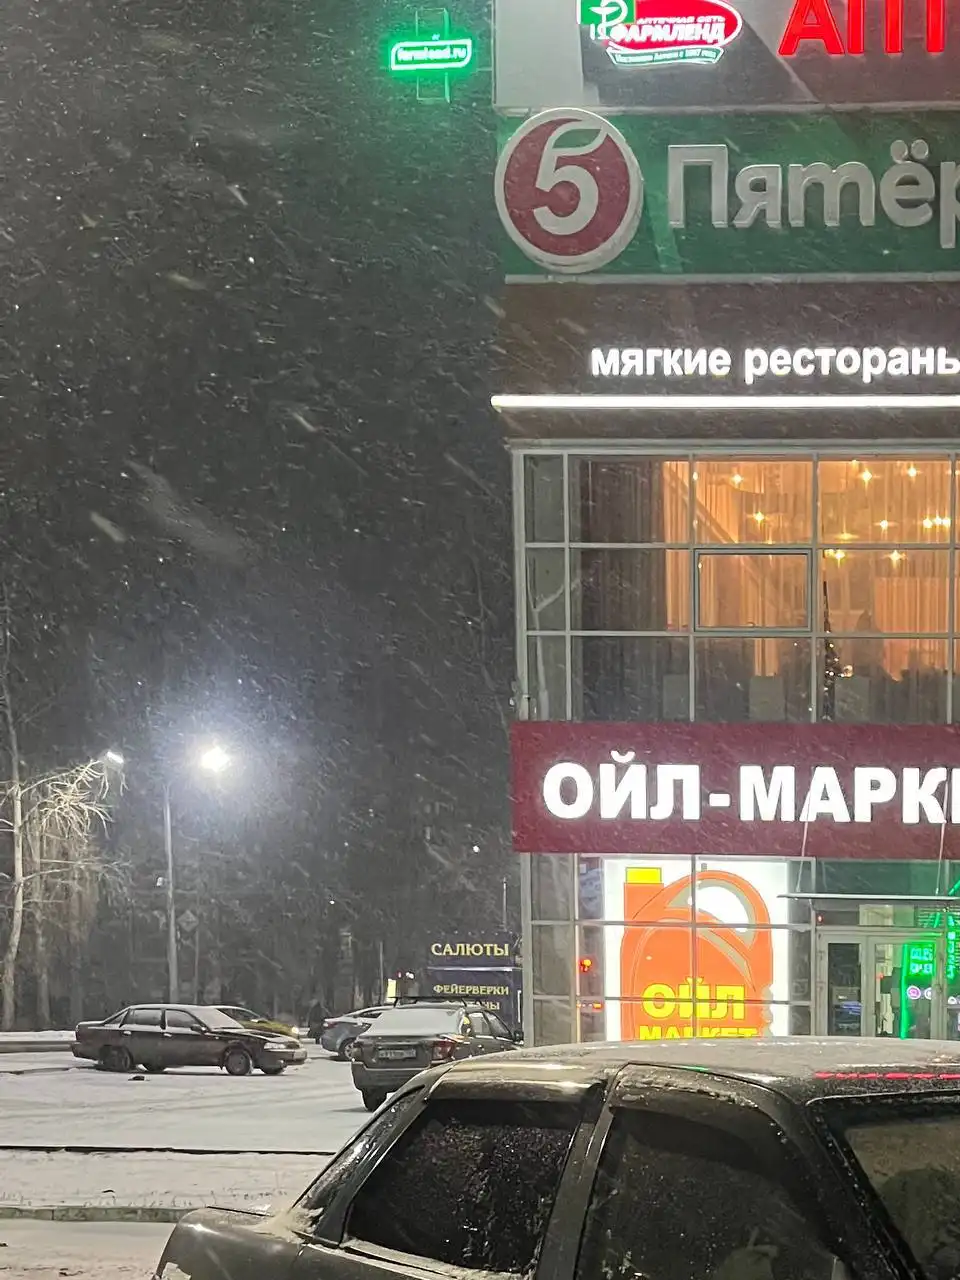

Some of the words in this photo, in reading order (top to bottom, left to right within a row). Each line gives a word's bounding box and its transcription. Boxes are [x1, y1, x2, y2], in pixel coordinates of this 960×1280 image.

[590, 346, 732, 376] мягкие
[431, 943, 509, 956] САЛЮТЫ
[433, 984, 509, 995] ФЕЙЕРВЕРКИ
[642, 976, 746, 1019] ОЙЛ
